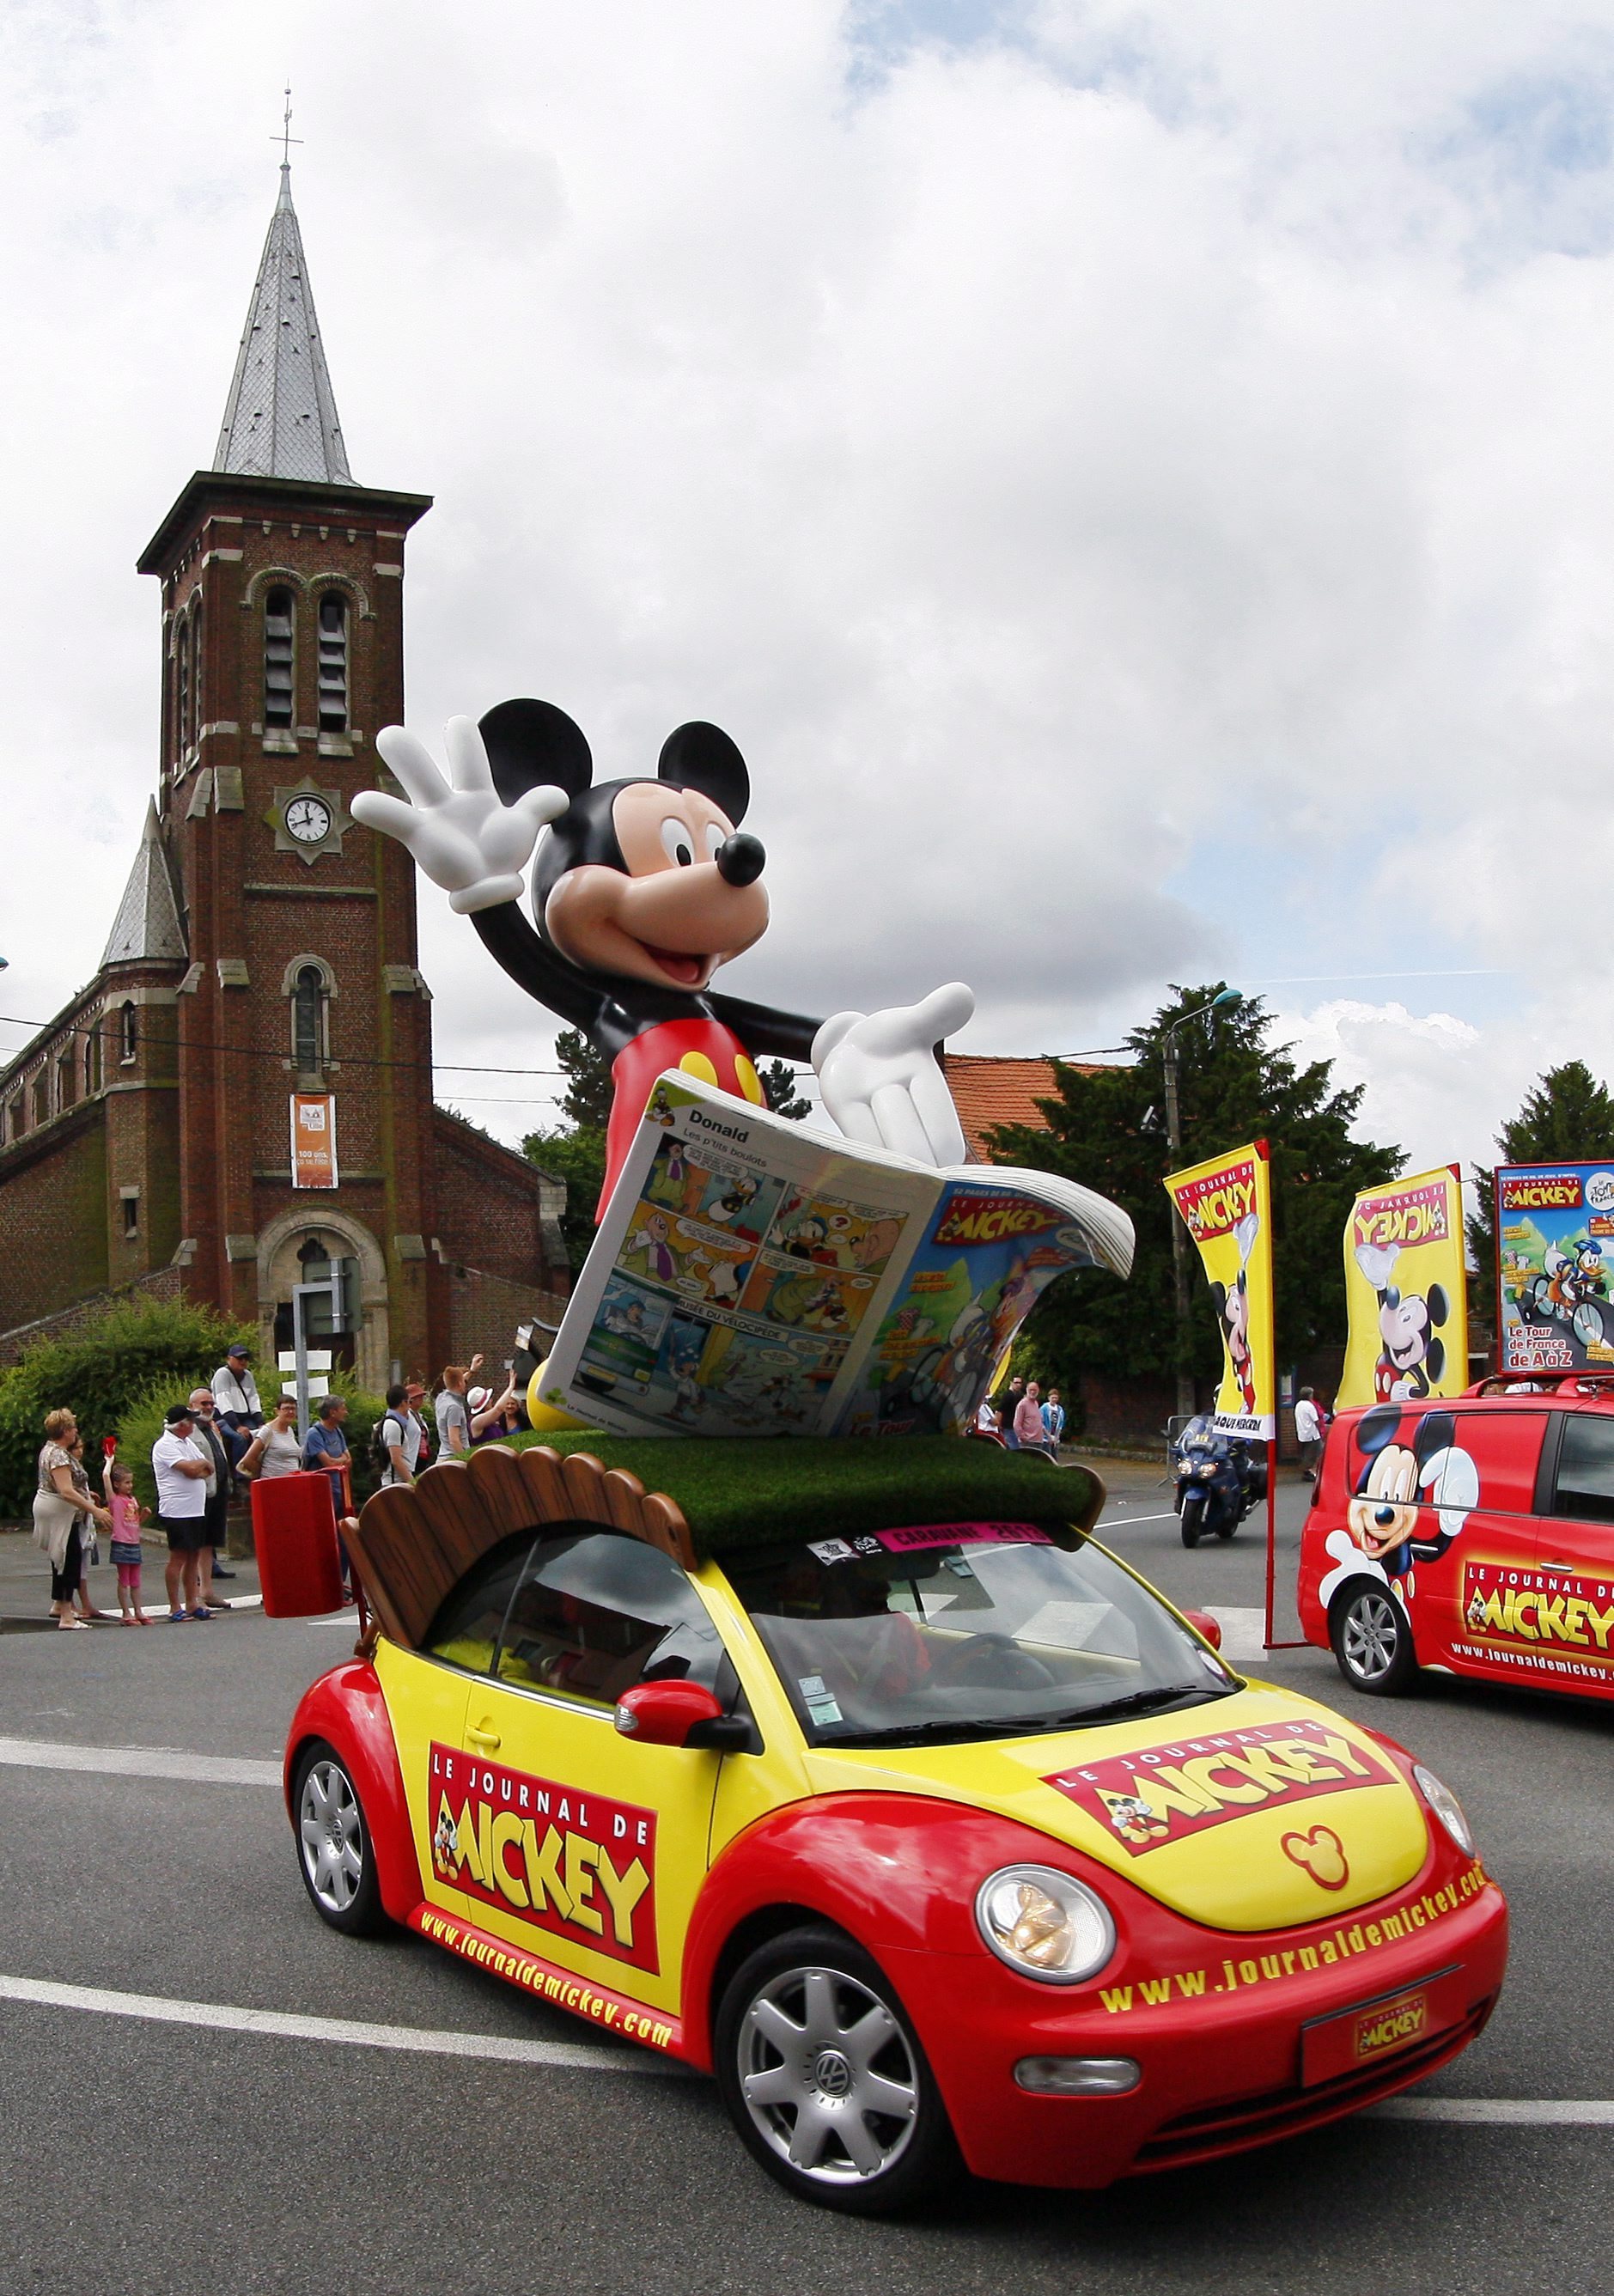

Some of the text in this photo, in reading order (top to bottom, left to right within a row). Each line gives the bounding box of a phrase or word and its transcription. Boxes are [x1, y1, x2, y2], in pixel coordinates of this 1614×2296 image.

[689, 1109, 750, 1143] Donald
[683, 1128, 700, 1142] Les
[703, 1136, 728, 1153] p'tits
[730, 1143, 768, 1168] boulots
[1178, 1164, 1253, 1200] LE JOURNAL DE
[1504, 1187, 1580, 1208] MICKEY
[951, 1199, 967, 1209] LE
[1188, 1178, 1254, 1230] MICKEY
[941, 1208, 1061, 1239] MICKEY
[706, 1309, 721, 1320] DU
[1509, 1327, 1551, 1337] Le Tour
[1509, 1339, 1565, 1349] de France
[1510, 1352, 1529, 1367] de
[1532, 1351, 1546, 1367] A
[1548, 1349, 1557, 1367] à
[1560, 1351, 1573, 1366] Z
[892, 1524, 984, 1546] CARAVANE
[1469, 1567, 1614, 1599] LE JOURNAL D
[1469, 1586, 1614, 1650] MICKEY
[1056, 1721, 1322, 1789] LE JOURNAL DE
[433, 1753, 648, 1846] LE JOURNAL DE
[1093, 1734, 1373, 1837] MICKEY
[435, 1789, 650, 1948] MICKEY
[420, 1911, 673, 2048] www.journaldemickey.com
[1360, 2007, 1423, 2046] MICKEY
